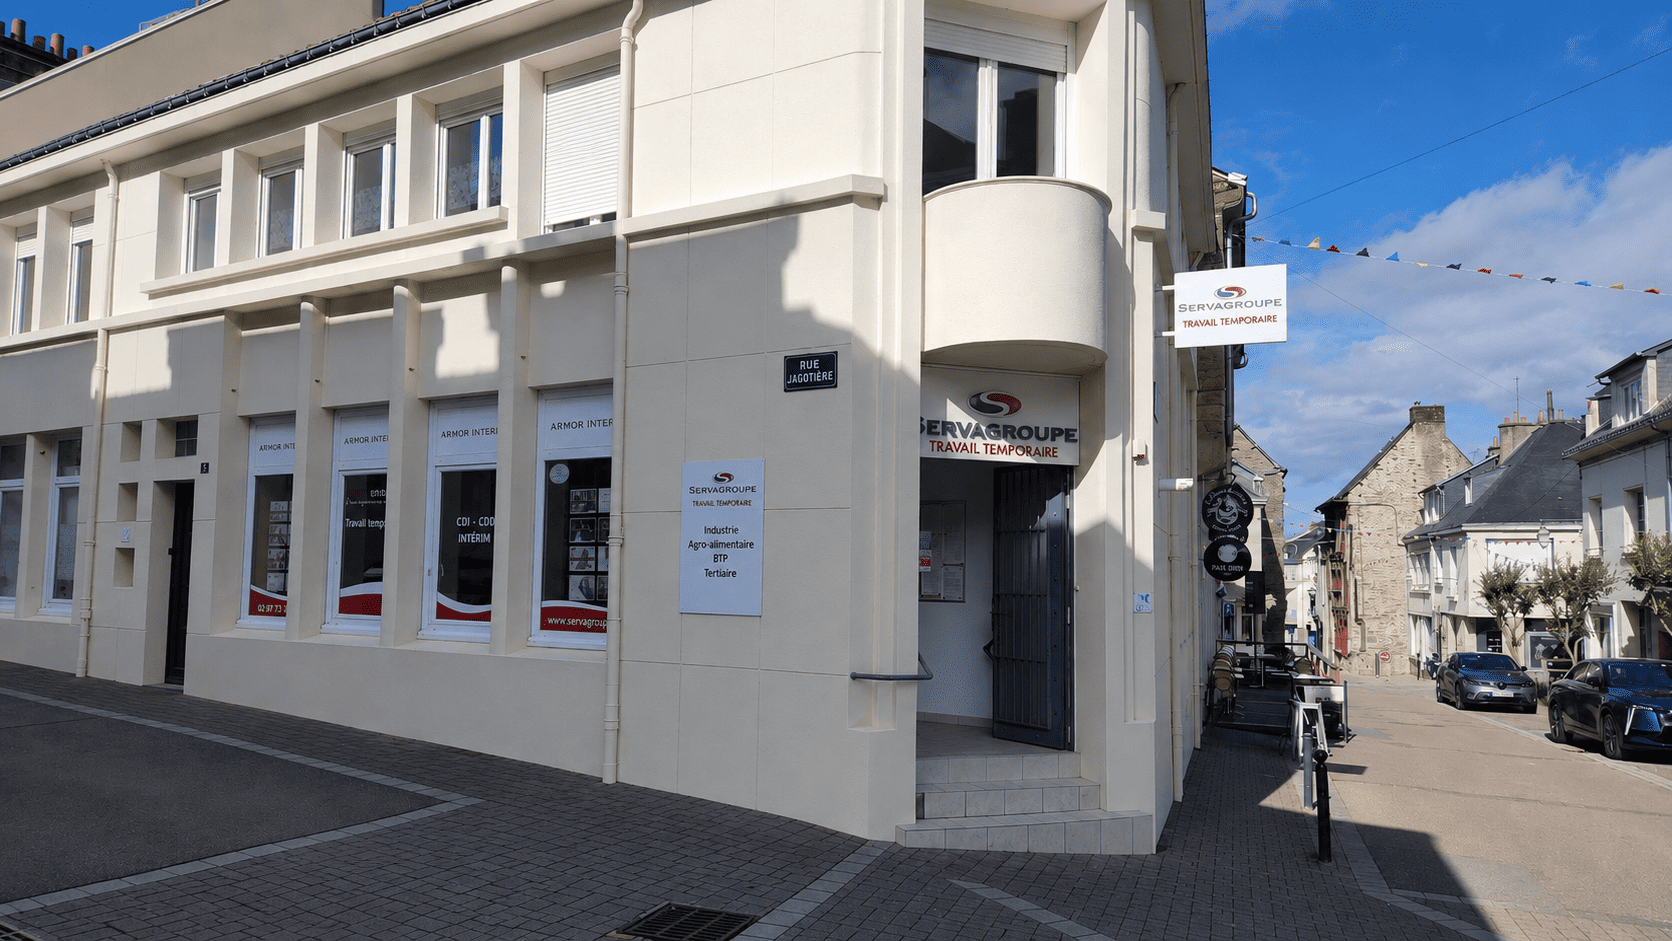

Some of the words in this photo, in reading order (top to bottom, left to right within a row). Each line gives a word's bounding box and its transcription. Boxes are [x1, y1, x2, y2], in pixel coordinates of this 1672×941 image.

[1178, 298, 1282, 313] SERVAGROUPE
[1183, 318, 1218, 329] TRAVAIL
[1220, 315, 1278, 326] TEMPORAIRE
[800, 359, 820, 370] RUE
[787, 369, 834, 384] JAGOTIÈRE
[550, 420, 584, 431] ARMOR
[441, 429, 470, 438] ARMOR
[344, 436, 370, 445] ARMOR
[371, 434, 389, 443] INTE
[259, 443, 281, 451] ARMOR
[929, 440, 980, 454] TRAVAIL
[983, 443, 1058, 458] TEMPORAIRE
[689, 485, 757, 494] SERVAGROUPE
[345, 518, 367, 528] Travail
[456, 517, 470, 527] CDI
[704, 525, 739, 535] Industrie
[458, 530, 491, 543] INTÉRIM
[688, 540, 754, 551] Agro-alimentaire
[713, 554, 728, 563] BTP
[704, 568, 737, 578] Tertiaire
